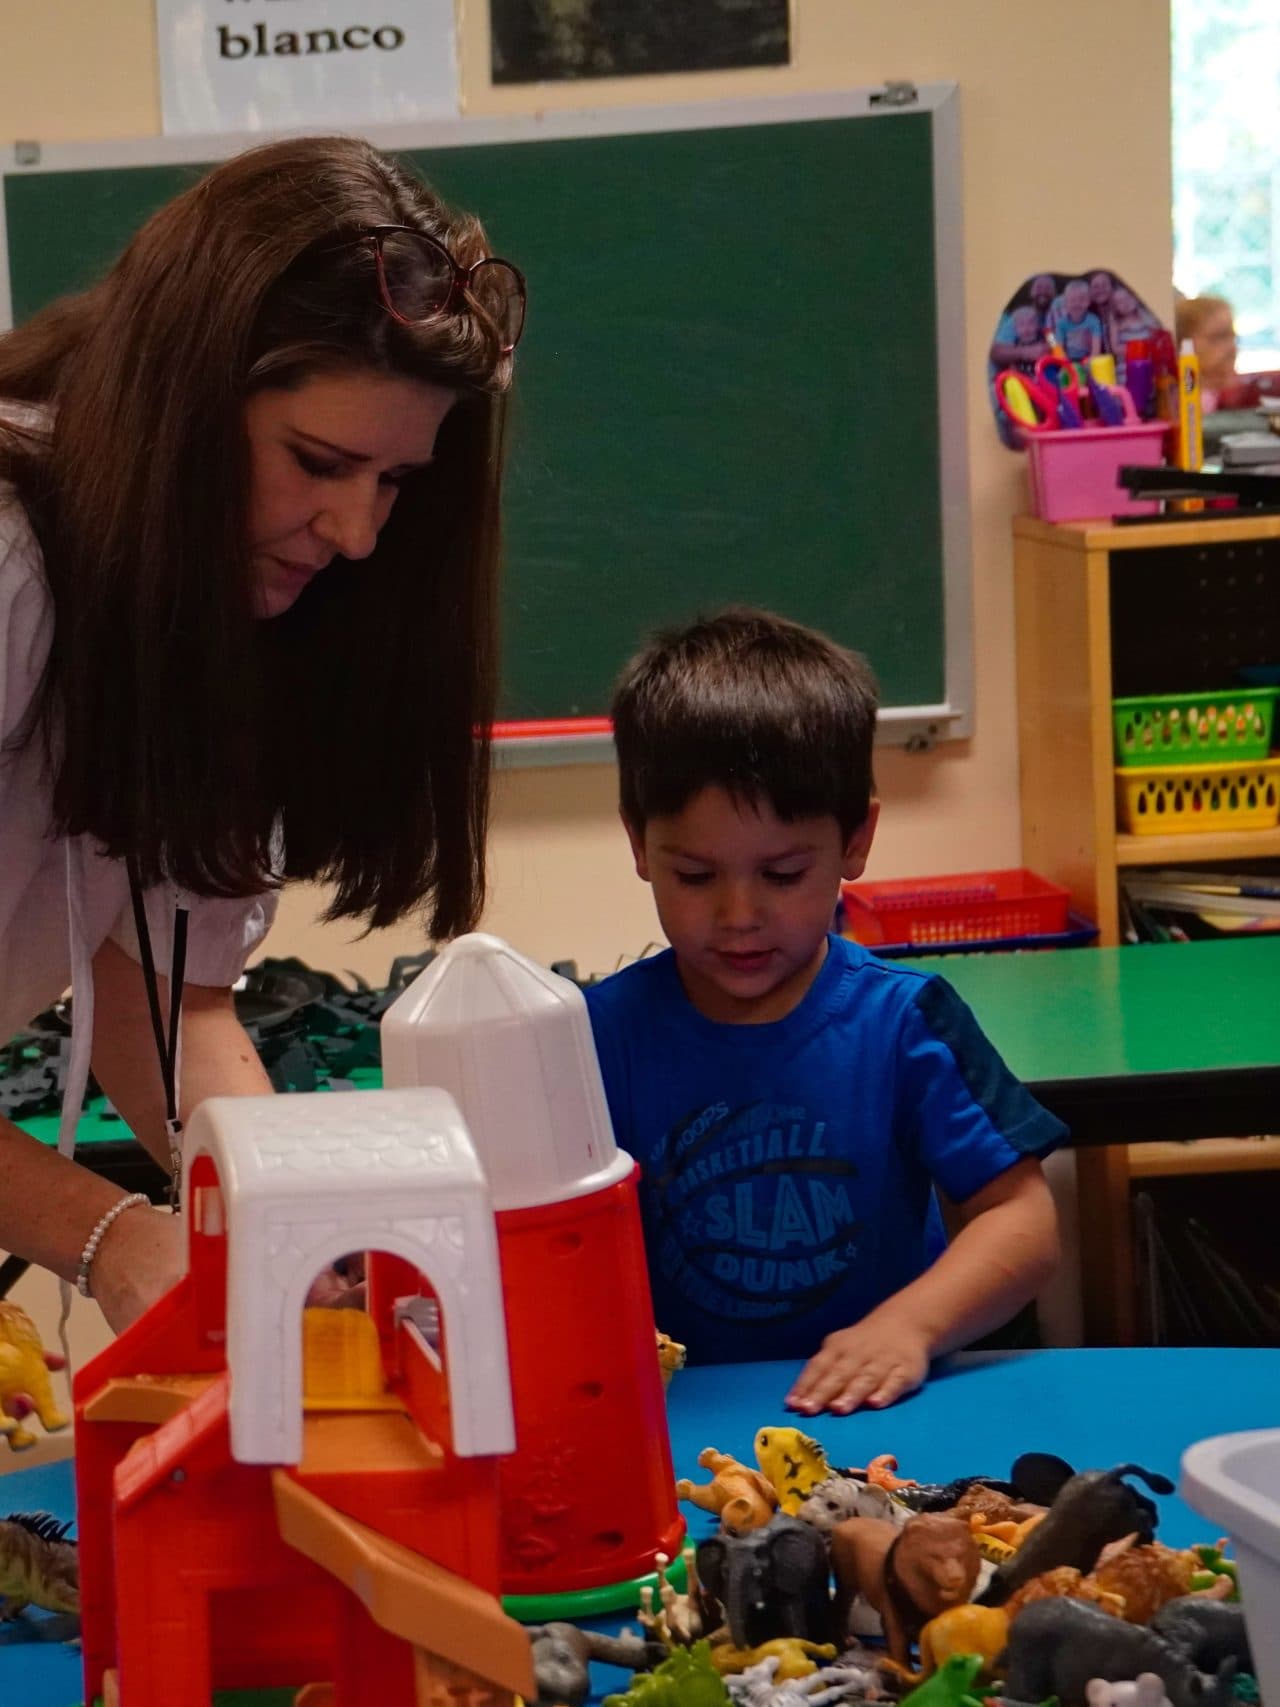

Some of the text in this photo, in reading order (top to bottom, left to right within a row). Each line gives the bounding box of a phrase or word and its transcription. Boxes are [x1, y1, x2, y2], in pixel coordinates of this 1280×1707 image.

[215, 21, 407, 61] blanco
[705, 1174, 855, 1251] SLAM
[713, 1247, 849, 1293] DUNK
